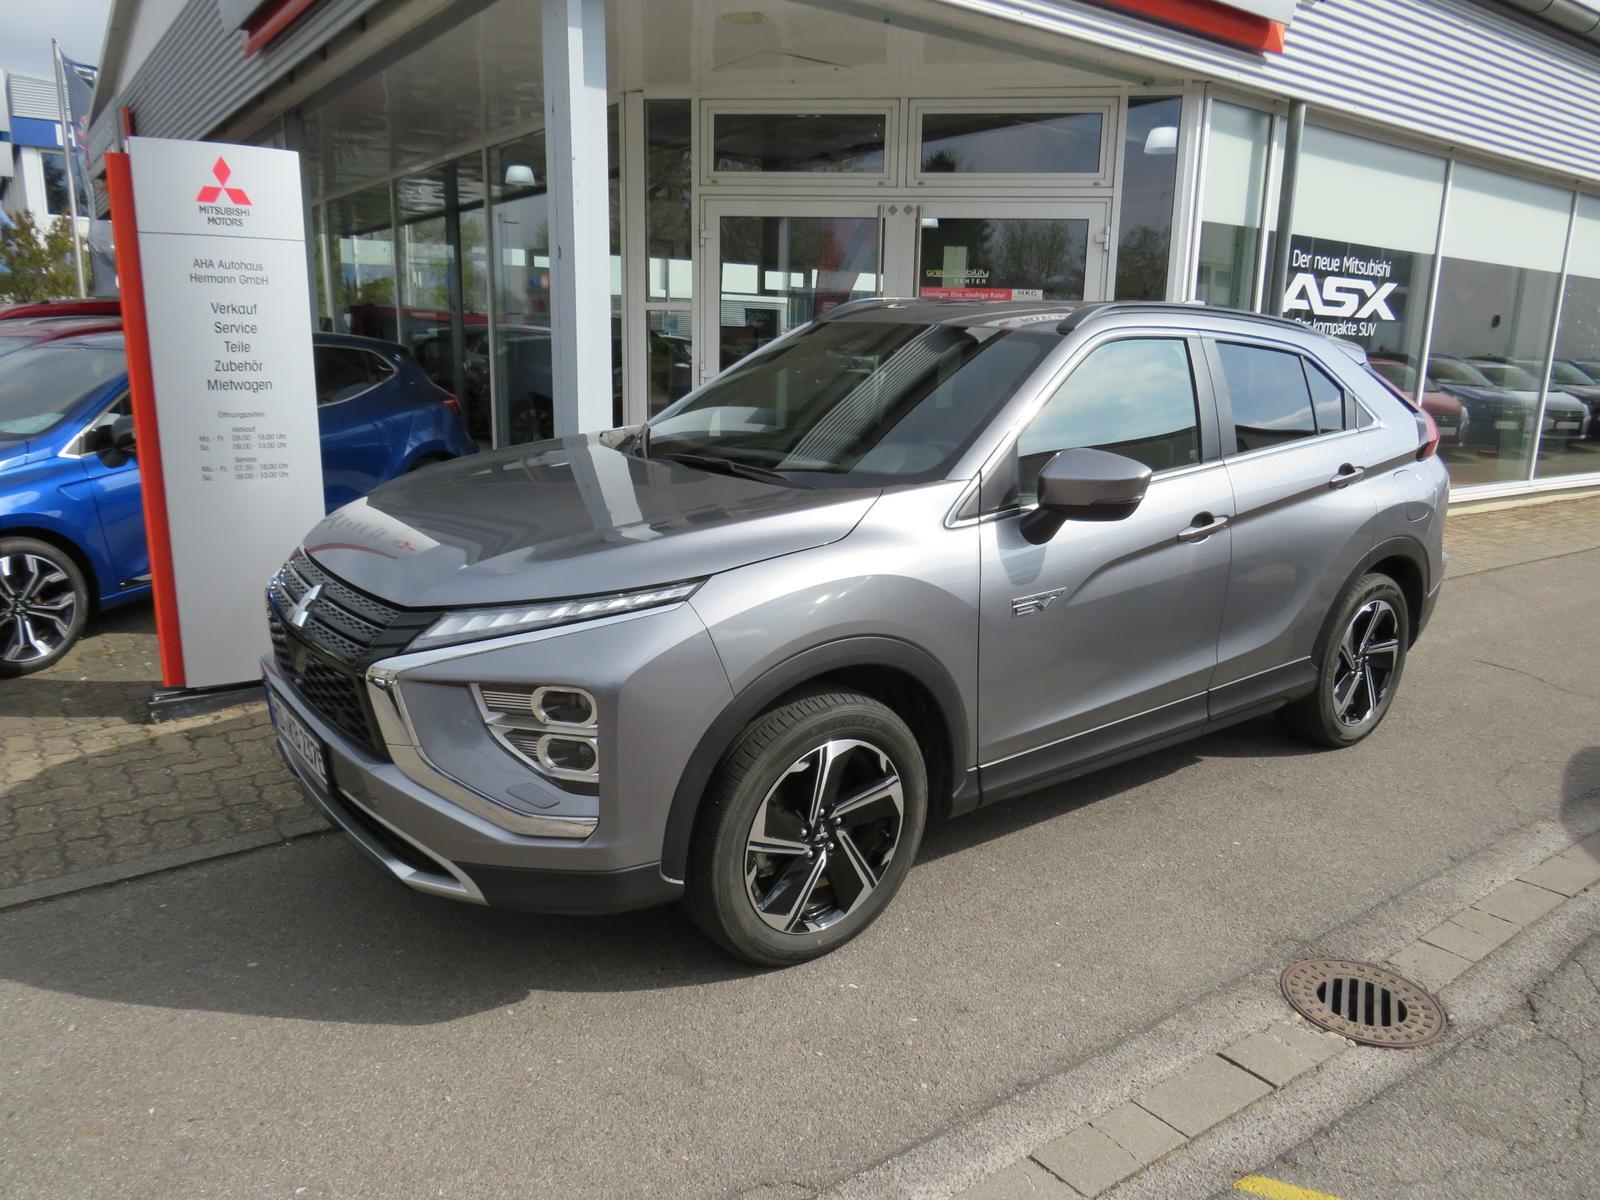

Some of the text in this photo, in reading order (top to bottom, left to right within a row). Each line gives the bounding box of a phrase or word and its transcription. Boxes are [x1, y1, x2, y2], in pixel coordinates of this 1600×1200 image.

[198, 205, 251, 217] MITSUBISHI
[207, 217, 244, 227] MOTORS
[193, 259, 264, 272] AHA Autohaus
[1292, 249, 1392, 278] Der neue Mitsubishi
[189, 273, 269, 286] Hermann GmbH
[1016, 289, 1038, 297] MKG
[1282, 272, 1399, 321] ASX
[210, 302, 258, 315] Verkauf
[214, 321, 258, 334] Service
[1312, 318, 1357, 336] kompakte
[1359, 322, 1377, 337] SUV
[224, 340, 251, 353] Teile
[214, 359, 263, 373] Zubehör
[207, 379, 273, 393] Mietwagen
[231, 425, 256, 433] Verkauf
